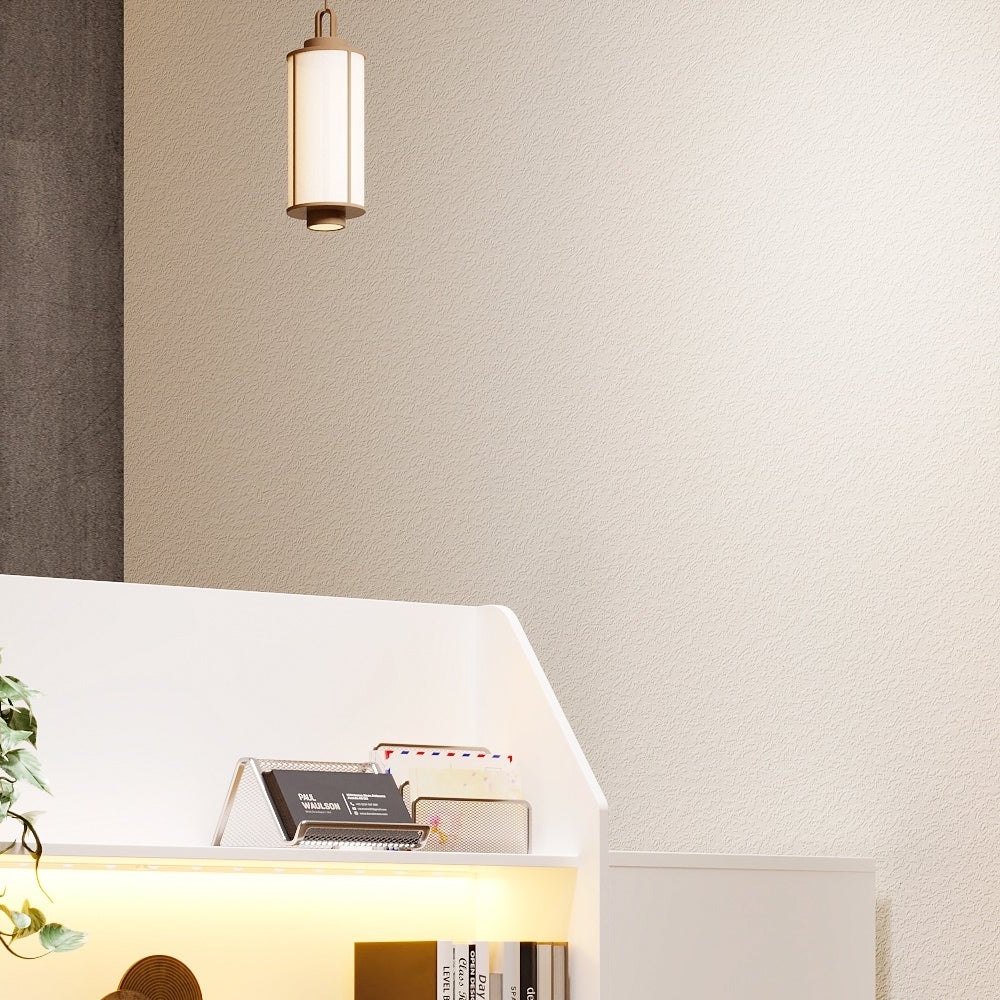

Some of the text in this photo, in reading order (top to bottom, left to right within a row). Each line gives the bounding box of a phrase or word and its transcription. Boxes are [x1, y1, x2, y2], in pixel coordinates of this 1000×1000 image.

[298, 793, 316, 801] PAUL
[301, 802, 341, 810] WAULSON
[458, 958, 467, 987] Class
[476, 975, 486, 999] Day
